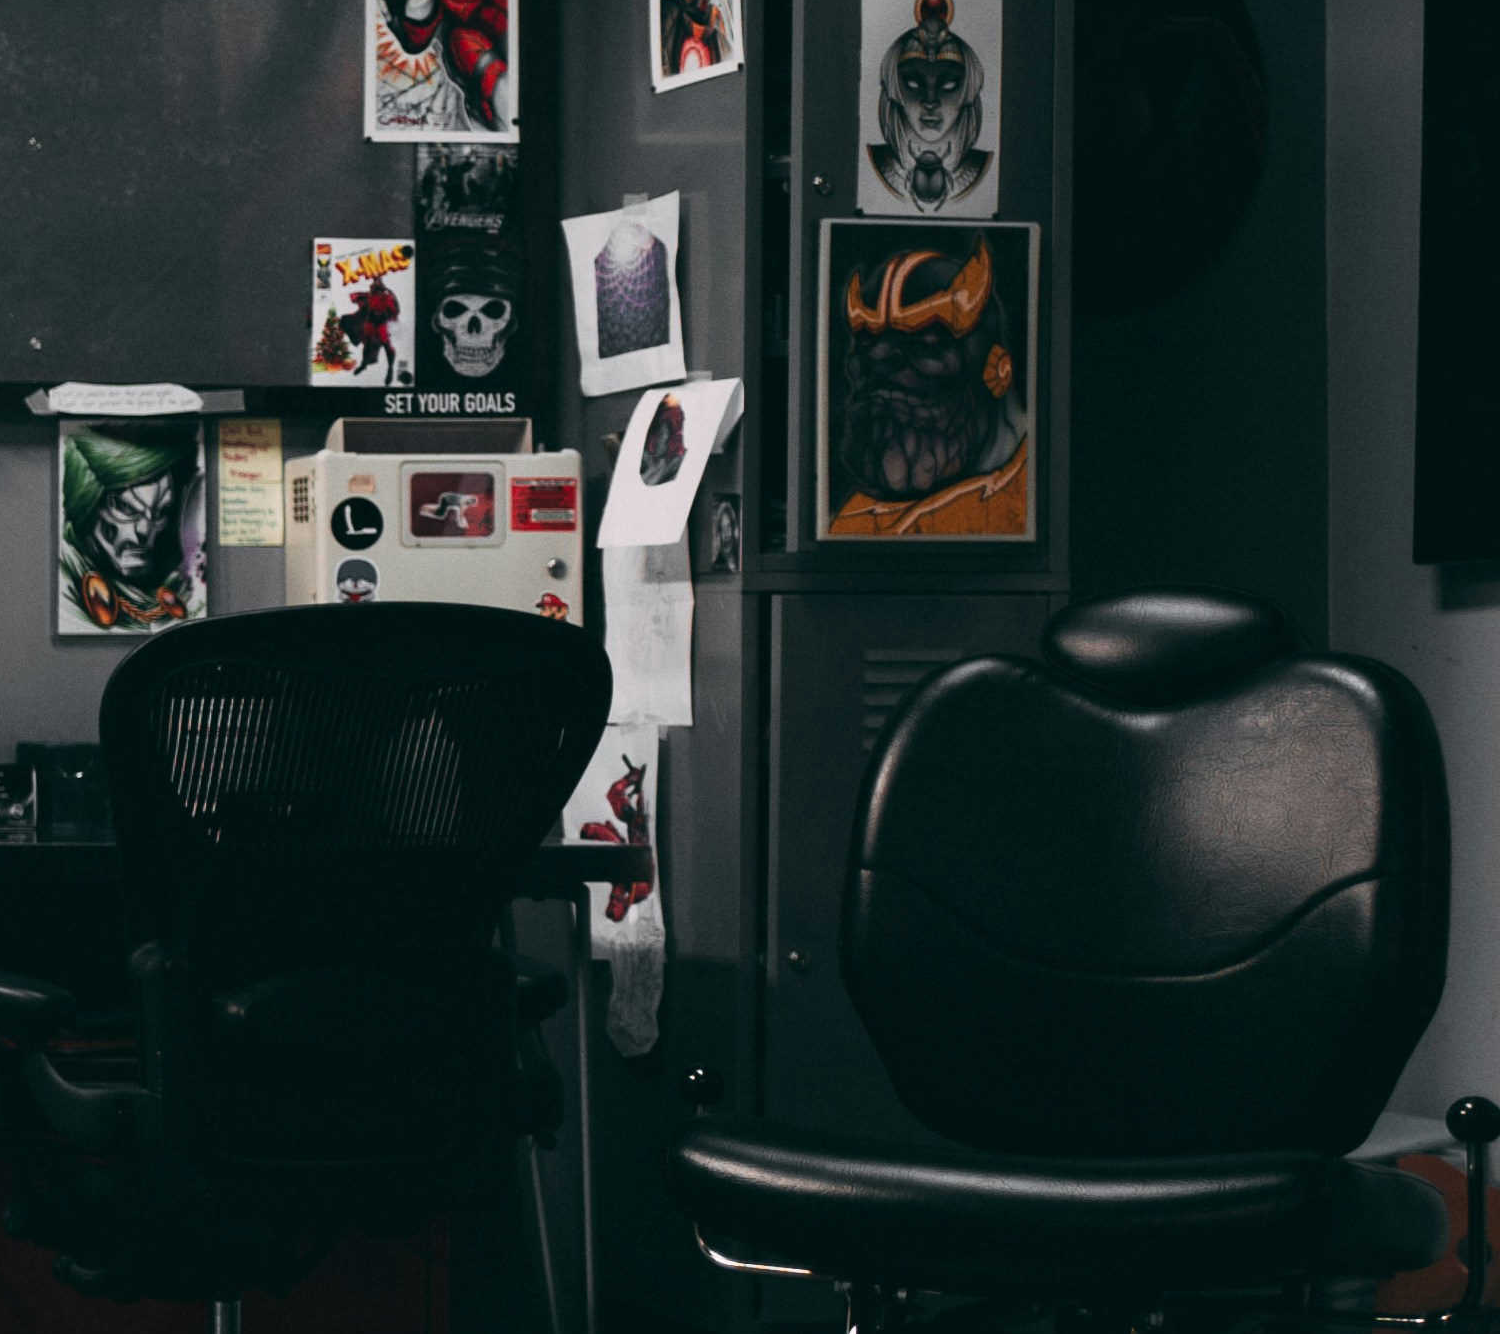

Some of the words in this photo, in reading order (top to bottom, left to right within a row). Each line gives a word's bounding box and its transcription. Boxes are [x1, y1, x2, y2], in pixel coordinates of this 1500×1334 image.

[336, 244, 411, 286] X-MAS
[384, 392, 415, 414] SET
[418, 392, 460, 414] YOUR
[464, 392, 515, 414] GOALS
